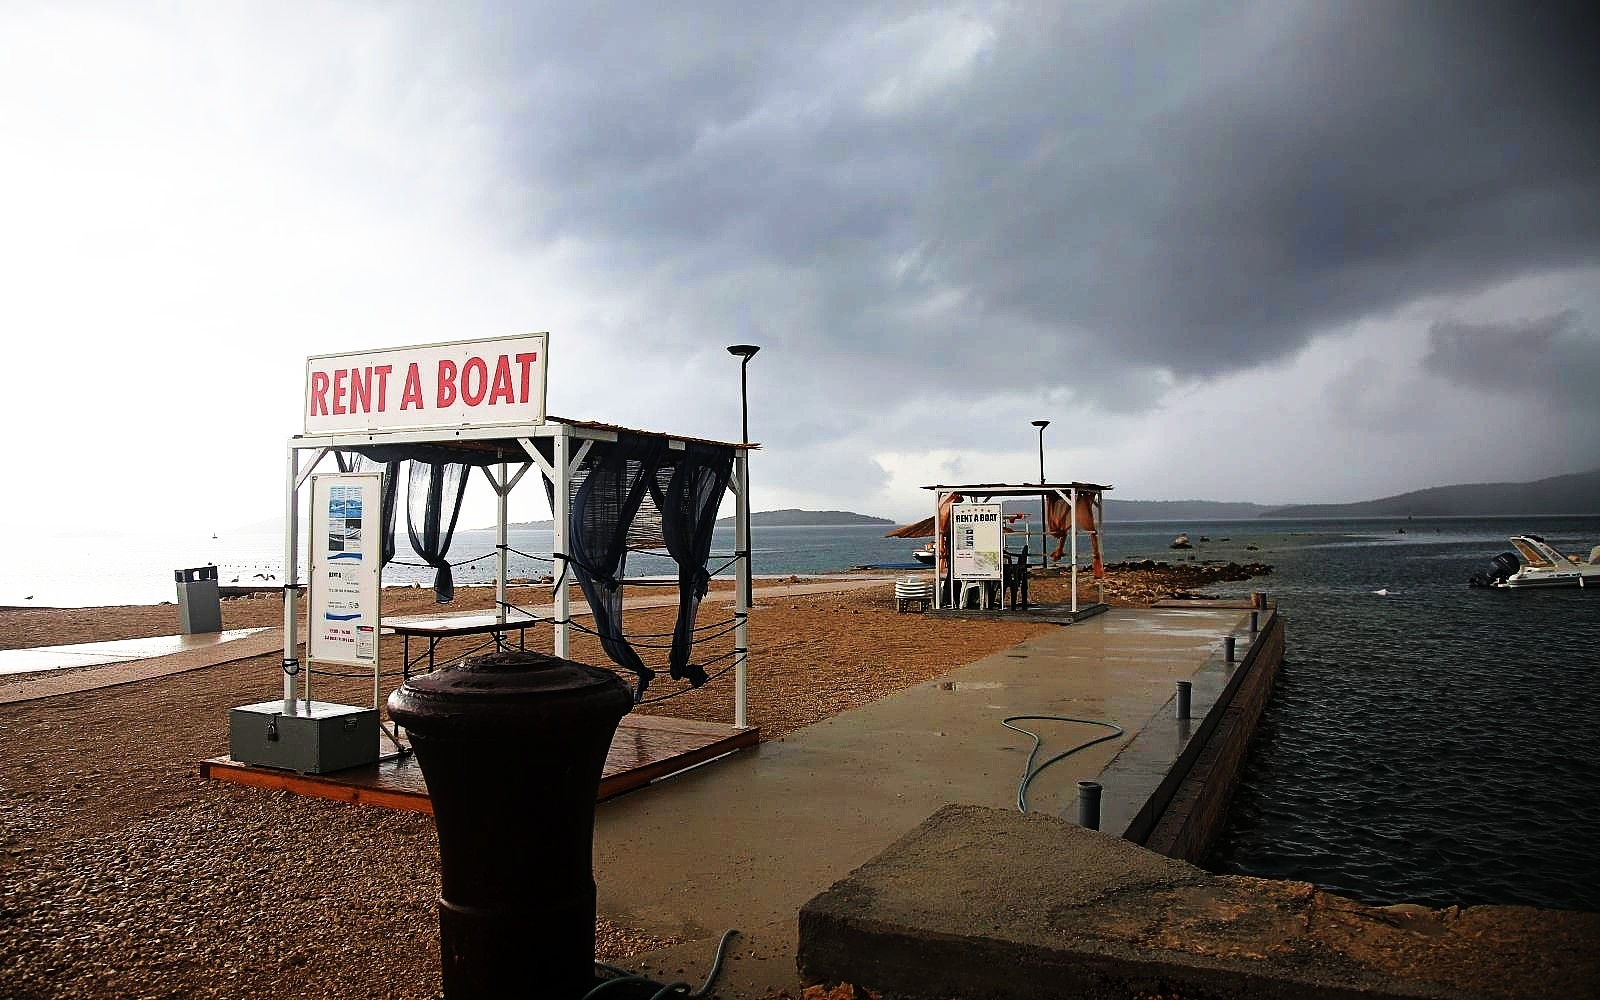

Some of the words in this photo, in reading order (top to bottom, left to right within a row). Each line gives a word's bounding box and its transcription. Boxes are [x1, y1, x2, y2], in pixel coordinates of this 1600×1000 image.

[310, 364, 393, 416] RENT
[399, 362, 425, 411] A
[436, 352, 537, 409] BOAT
[955, 514, 973, 523] RENT
[973, 513, 979, 522] A
[979, 513, 998, 522] BOAT
